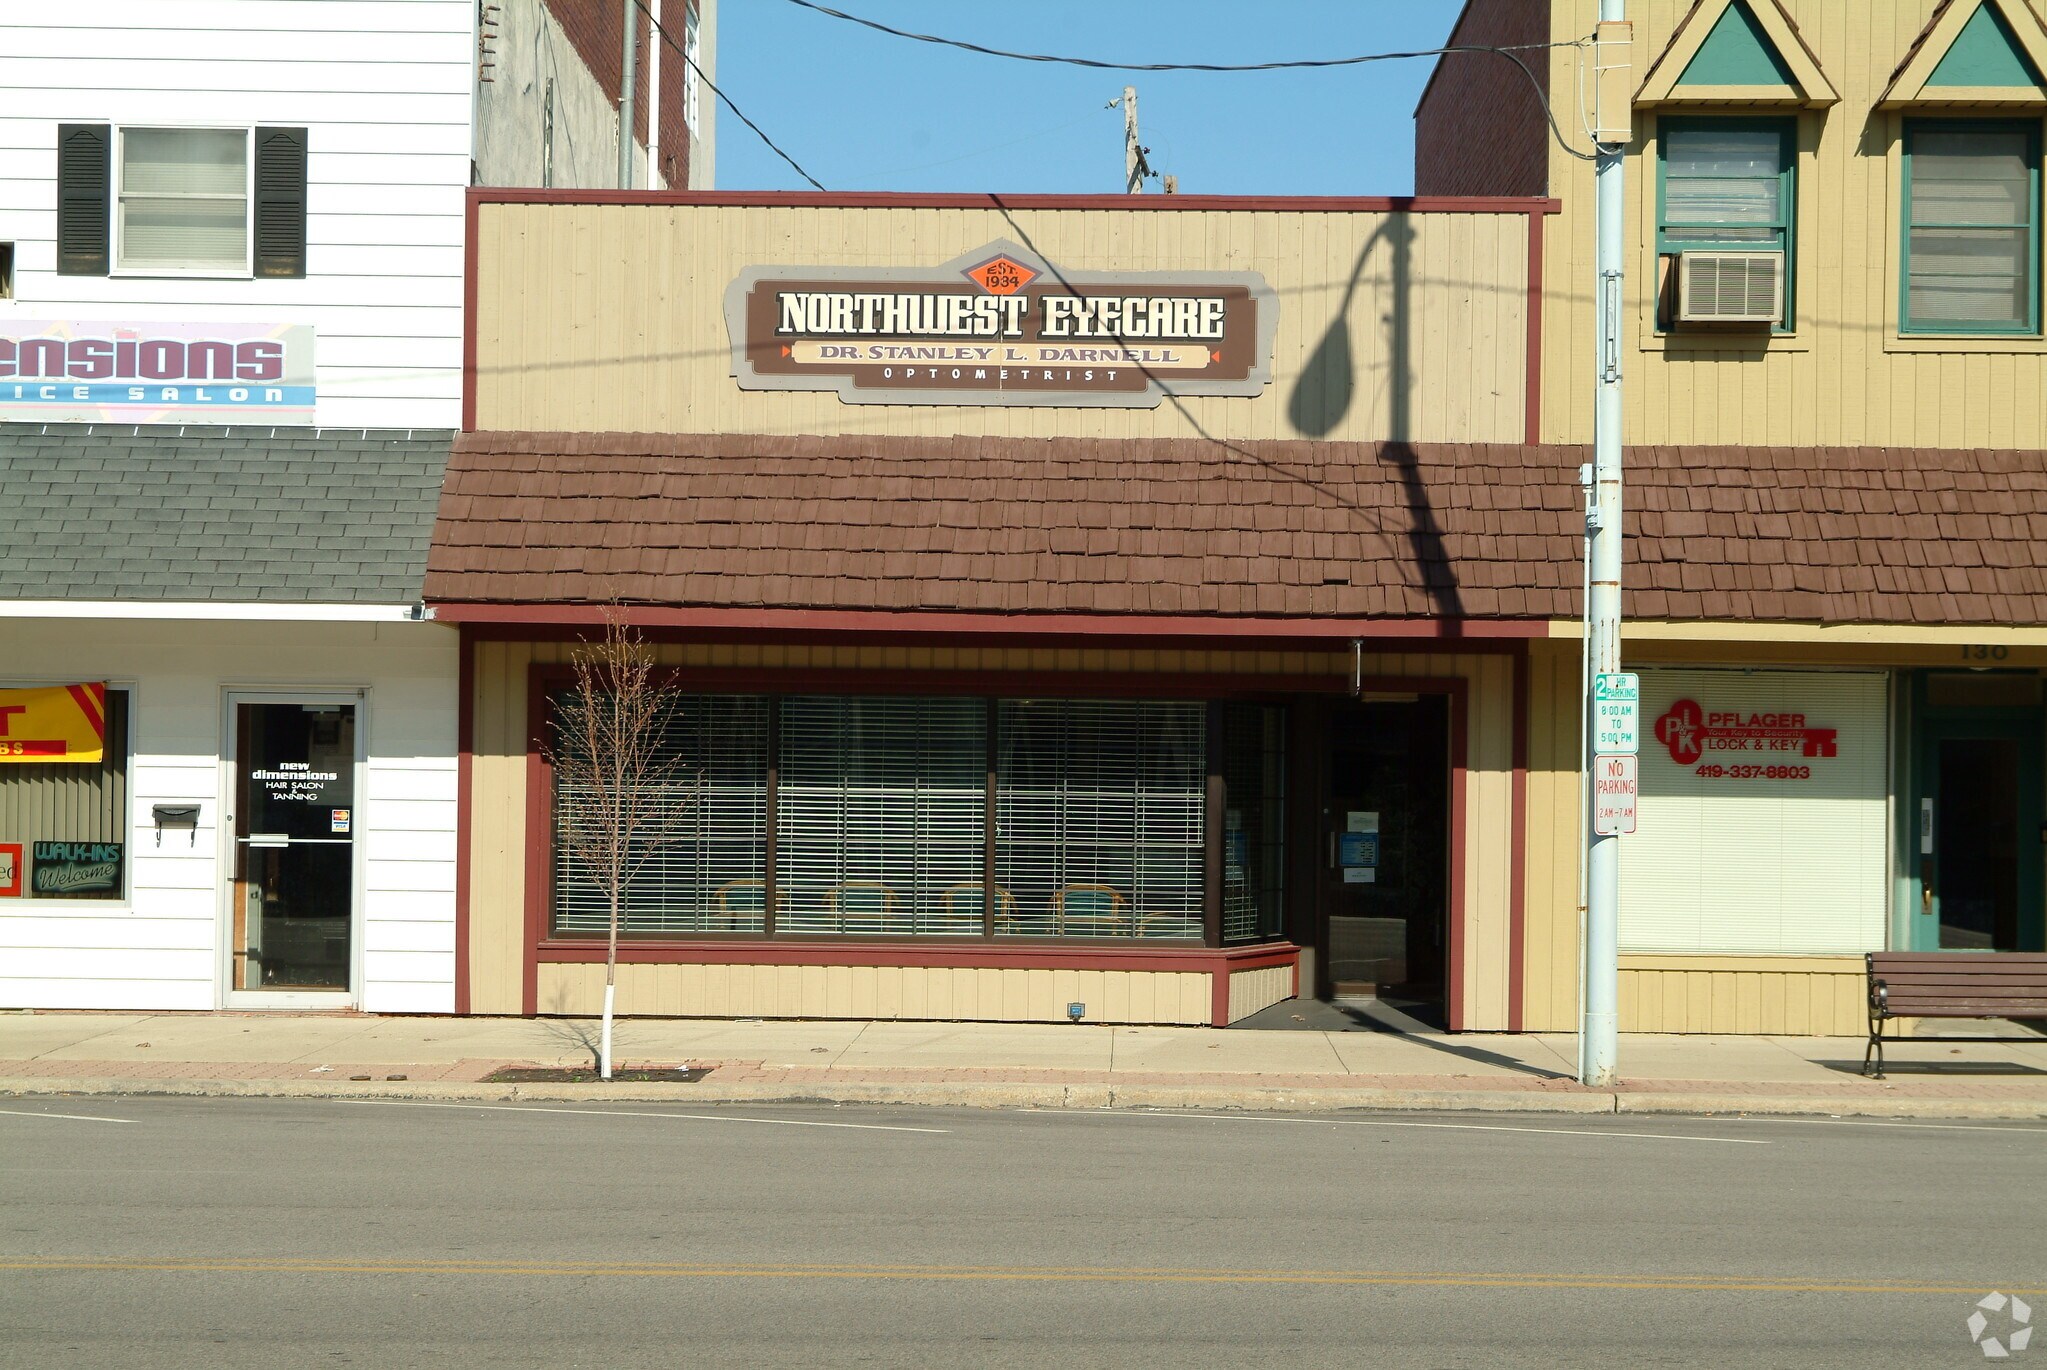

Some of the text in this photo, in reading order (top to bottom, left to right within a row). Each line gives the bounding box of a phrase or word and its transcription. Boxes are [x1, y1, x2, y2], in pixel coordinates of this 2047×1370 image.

[986, 262, 1018, 275] EST.
[985, 276, 1020, 288] 1934
[776, 292, 1226, 339] NORTHWEST EYECARE
[819, 345, 1182, 364] DR. STANLEY L. DARNELL
[883, 367, 1118, 381] OPTOMETRIST
[128, 387, 283, 402] SALON
[1961, 644, 2009, 661] 130
[1596, 677, 1607, 698] 2
[1606, 687, 1637, 698] PARKING
[1620, 705, 1633, 716] AM
[1611, 719, 1622, 729] TO
[1708, 712, 1806, 728] PFLAGER
[1620, 732, 1633, 743] PM
[1708, 738, 1800, 751] LOCK & KEY
[279, 762, 311, 771] new
[1608, 762, 1624, 777] NO
[1695, 764, 1811, 779] 419-337-8803
[252, 769, 338, 781] dimensions
[265, 781, 325, 790] HAIR SALON
[1597, 779, 1635, 795] PARKING
[272, 792, 319, 801] TANNING
[35, 842, 120, 863] WALK-INS
[40, 862, 114, 889] Welcome
